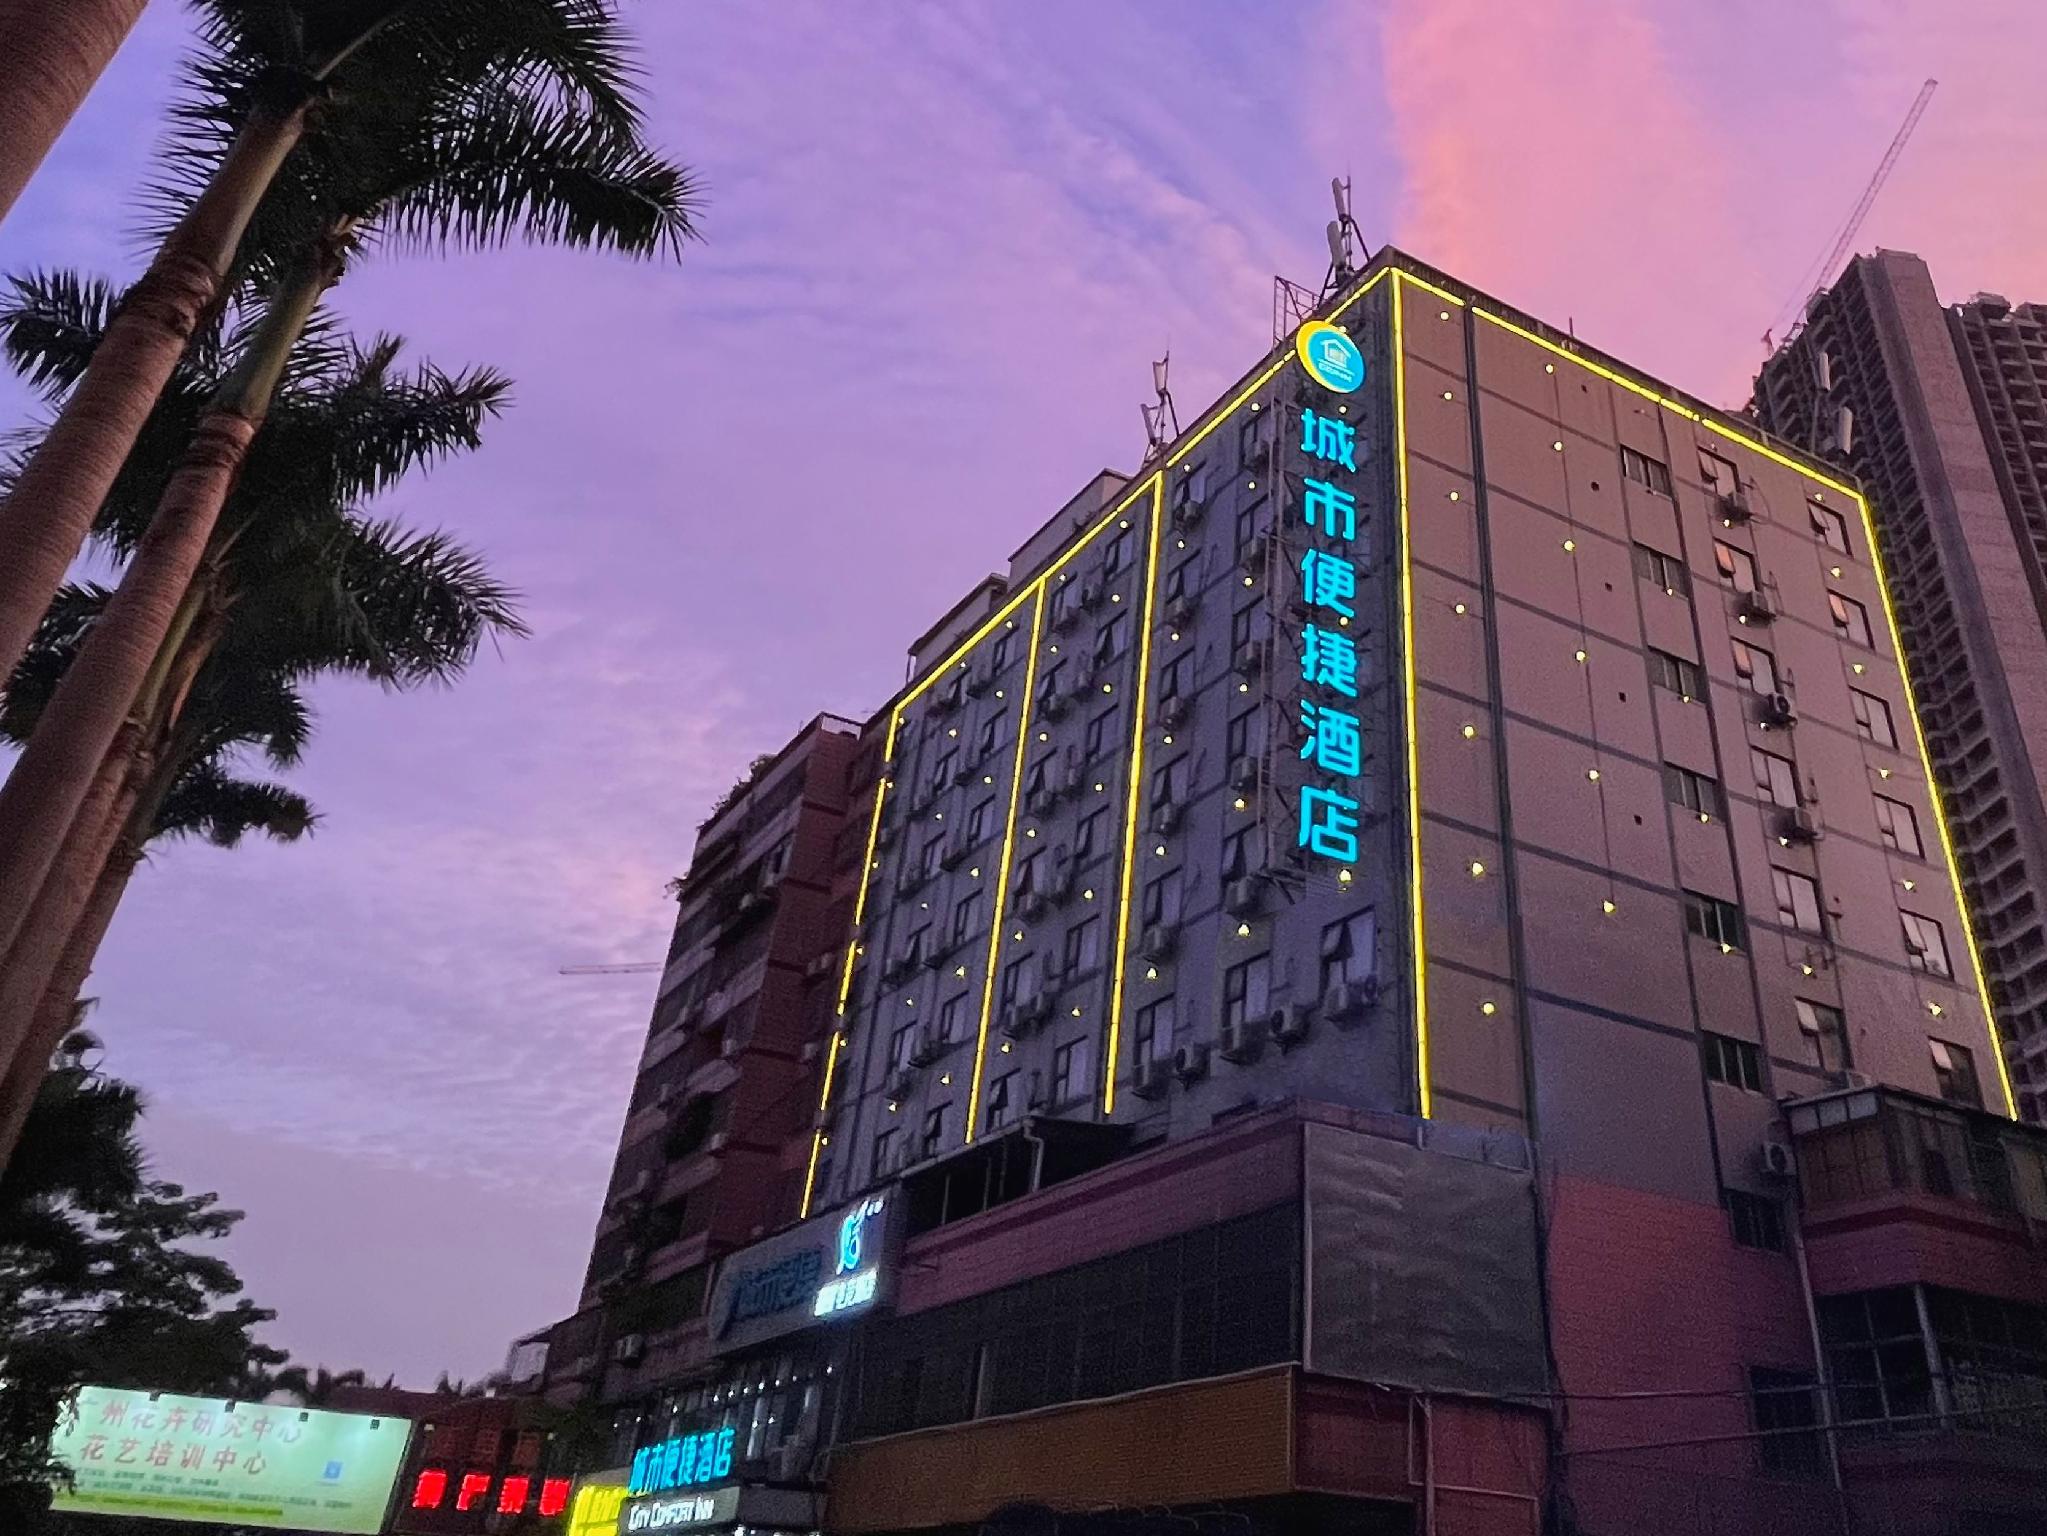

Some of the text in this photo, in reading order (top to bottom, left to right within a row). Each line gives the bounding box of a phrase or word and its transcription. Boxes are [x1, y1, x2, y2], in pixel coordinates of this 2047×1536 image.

[1299, 407, 1361, 864] 城市便捷酒店
[80, 1396, 301, 1444] 州花卉研究中心
[80, 1433, 267, 1475] 花艺培训中心
